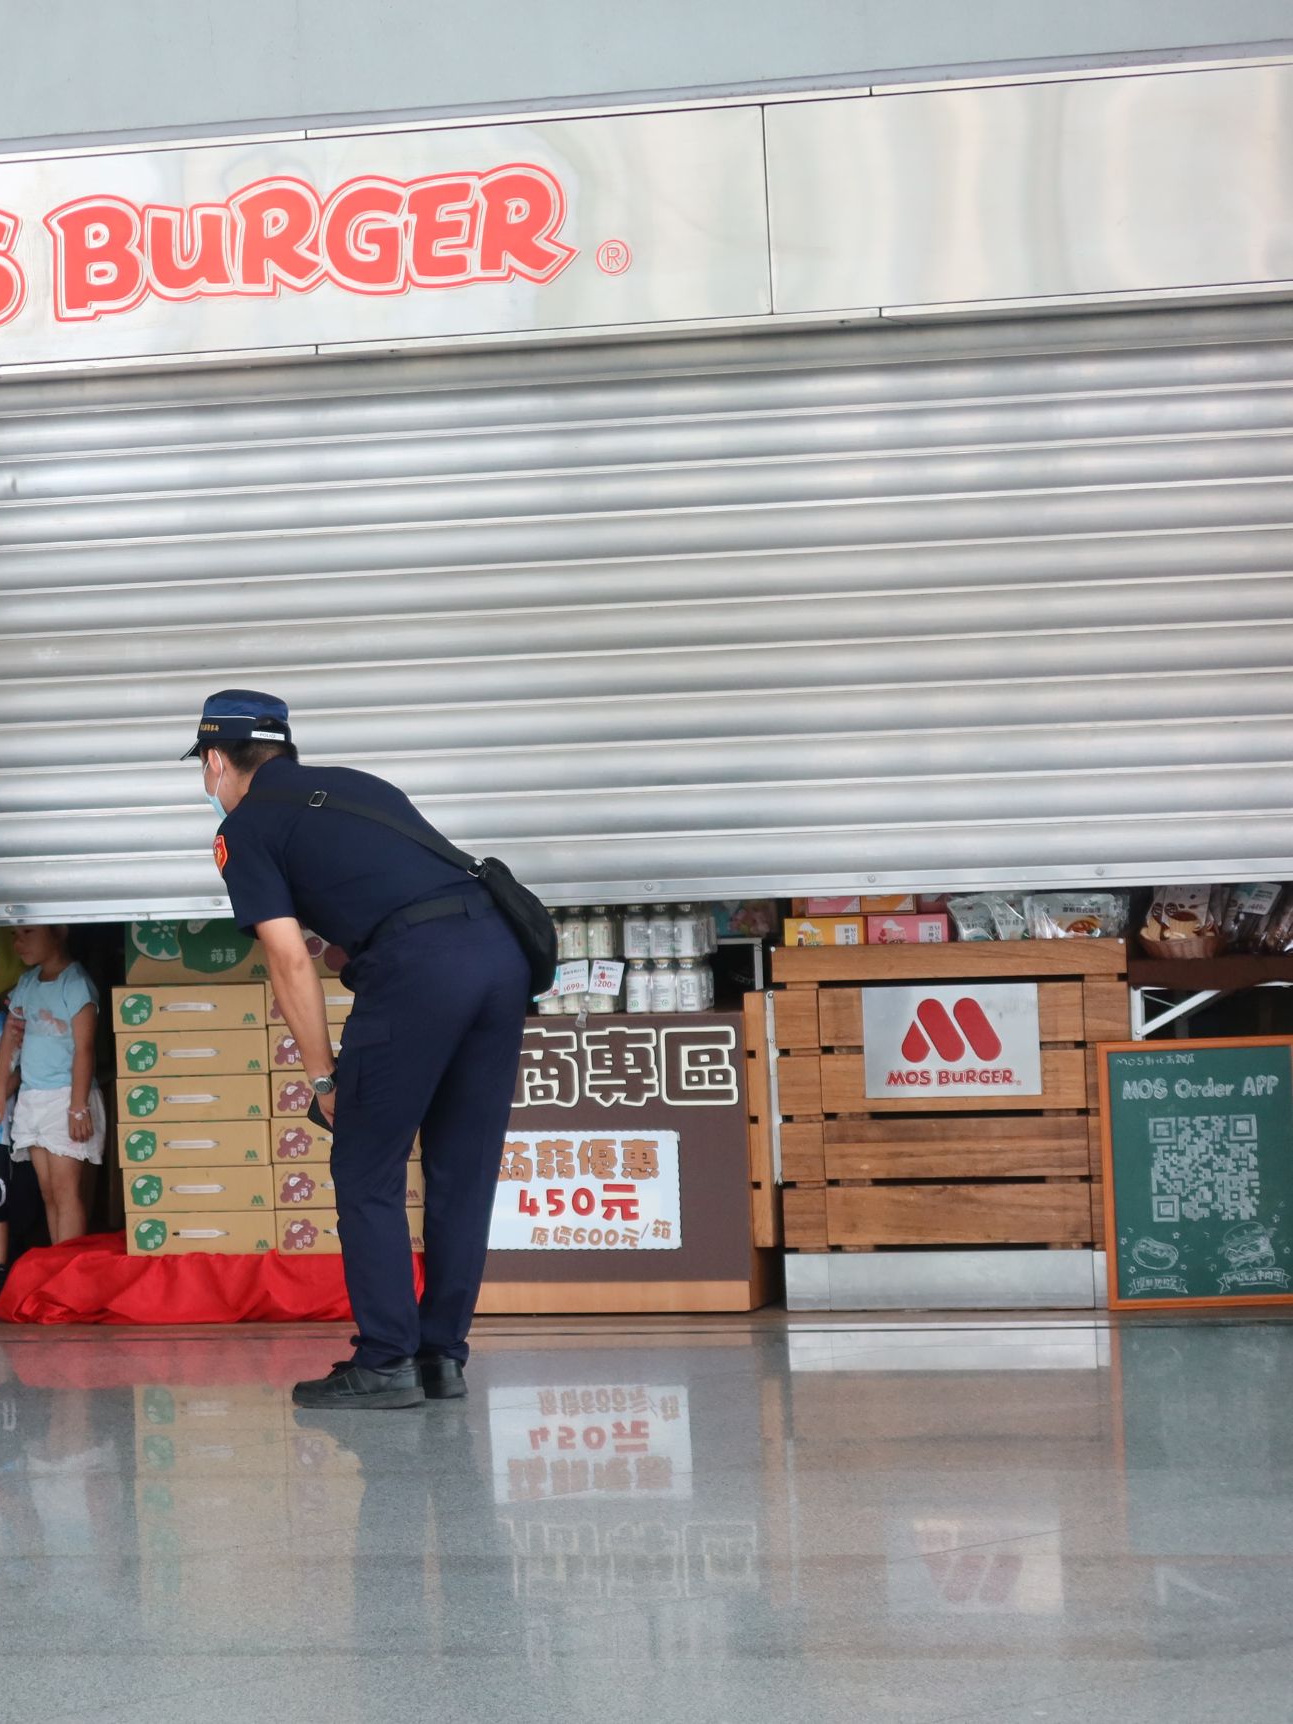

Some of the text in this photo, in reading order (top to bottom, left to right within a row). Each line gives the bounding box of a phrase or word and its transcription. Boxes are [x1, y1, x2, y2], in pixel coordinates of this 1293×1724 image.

[43, 162, 581, 323] BURGER
[886, 1068, 1015, 1087] MOS BURGER
[1122, 1074, 1279, 1100] MOS Order APP
[518, 1183, 640, 1221] 450元
